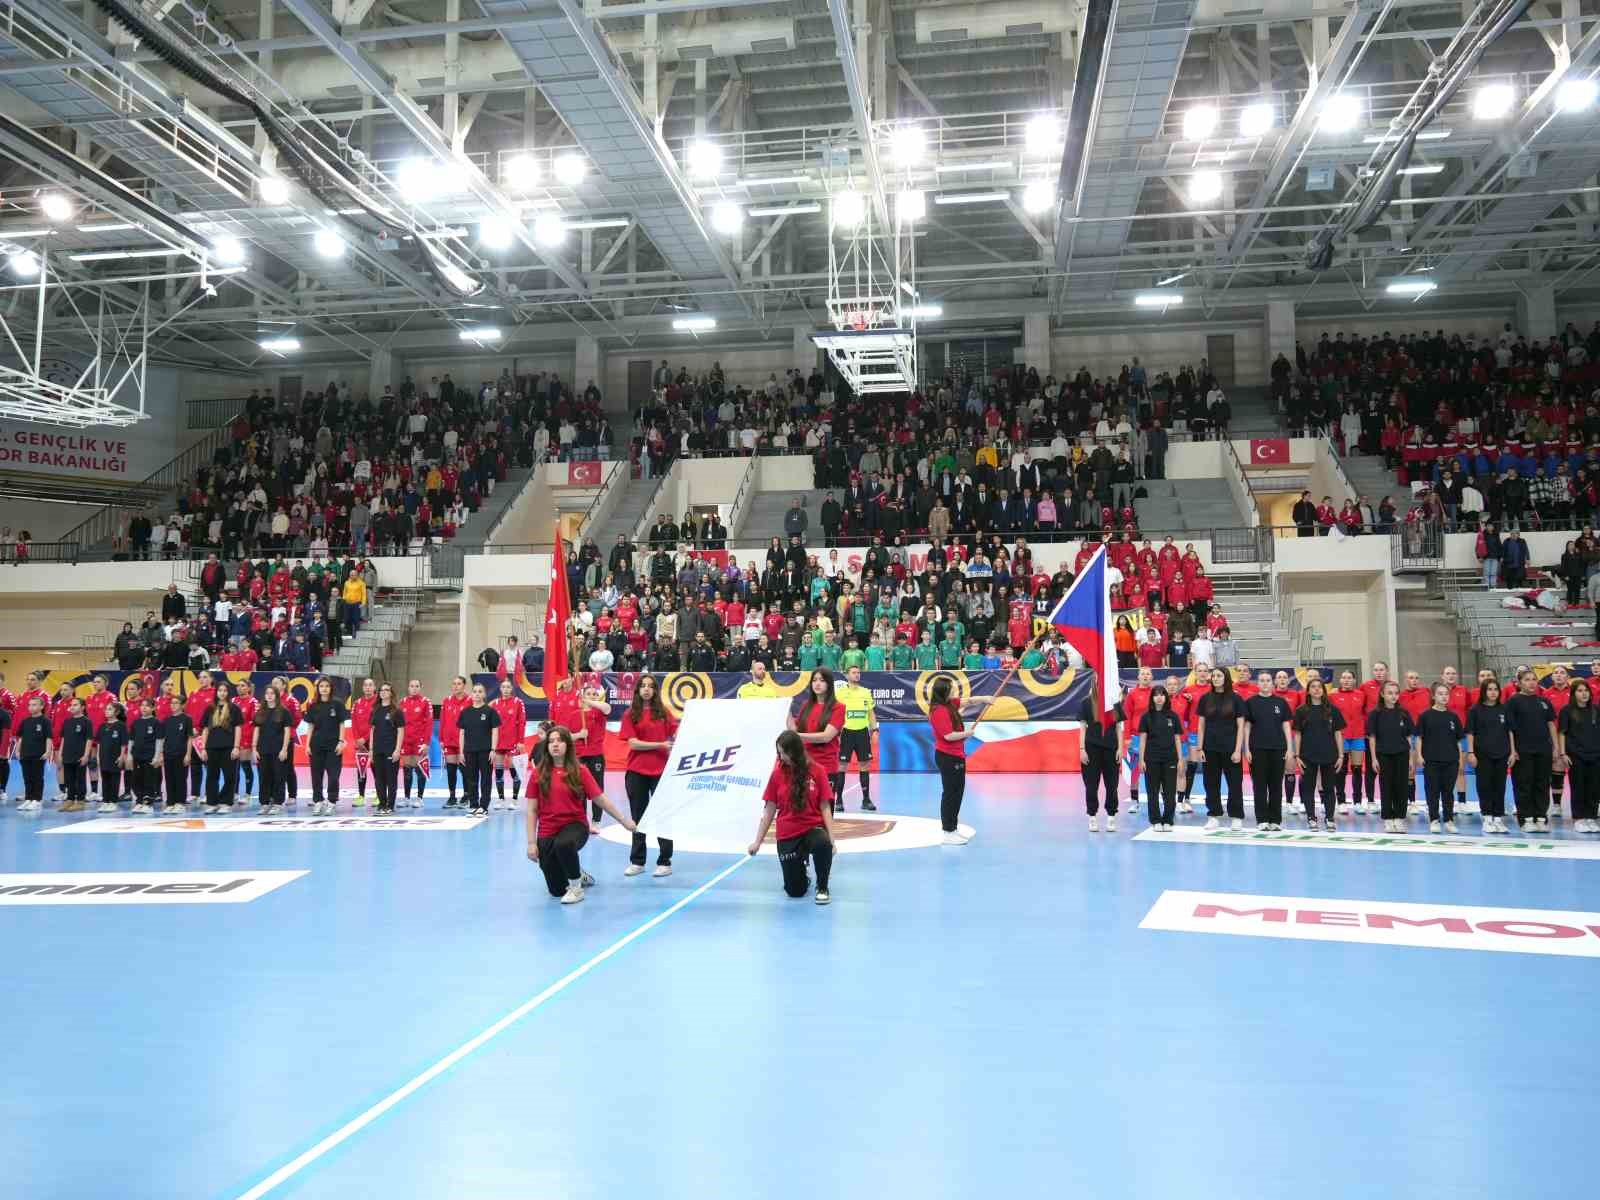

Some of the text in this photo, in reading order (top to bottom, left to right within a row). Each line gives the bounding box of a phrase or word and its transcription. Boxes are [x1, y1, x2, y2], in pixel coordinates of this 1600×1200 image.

[14, 431, 97, 451] GENÇLİK
[104, 441, 126, 455] VE
[28, 450, 126, 472] BAKANLIĞI
[891, 689, 905, 699] CUP
[676, 744, 742, 772] EHF
[0, 878, 256, 896] mmel
